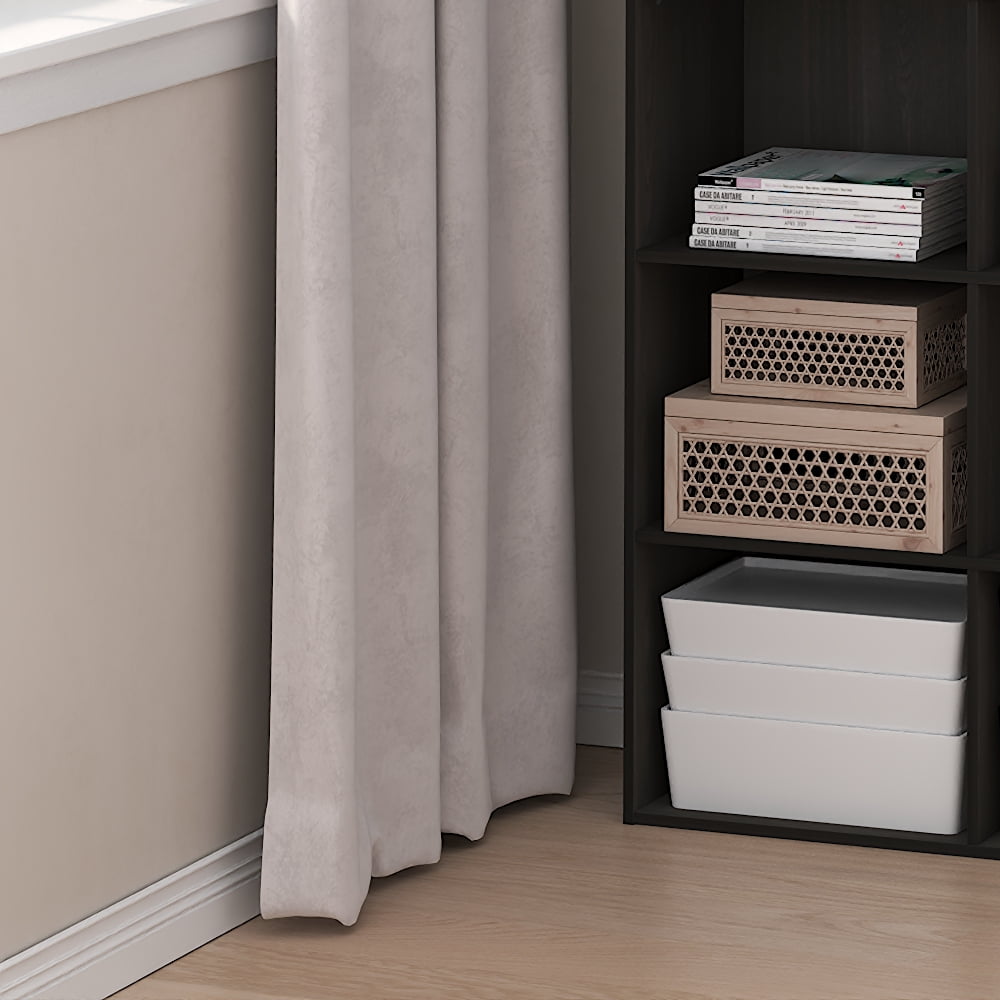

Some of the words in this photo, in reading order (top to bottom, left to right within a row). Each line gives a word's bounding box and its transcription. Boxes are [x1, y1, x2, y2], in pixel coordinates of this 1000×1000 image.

[699, 190, 714, 200] CASE
[696, 226, 711, 236] CASE
[694, 238, 708, 248] CASE
